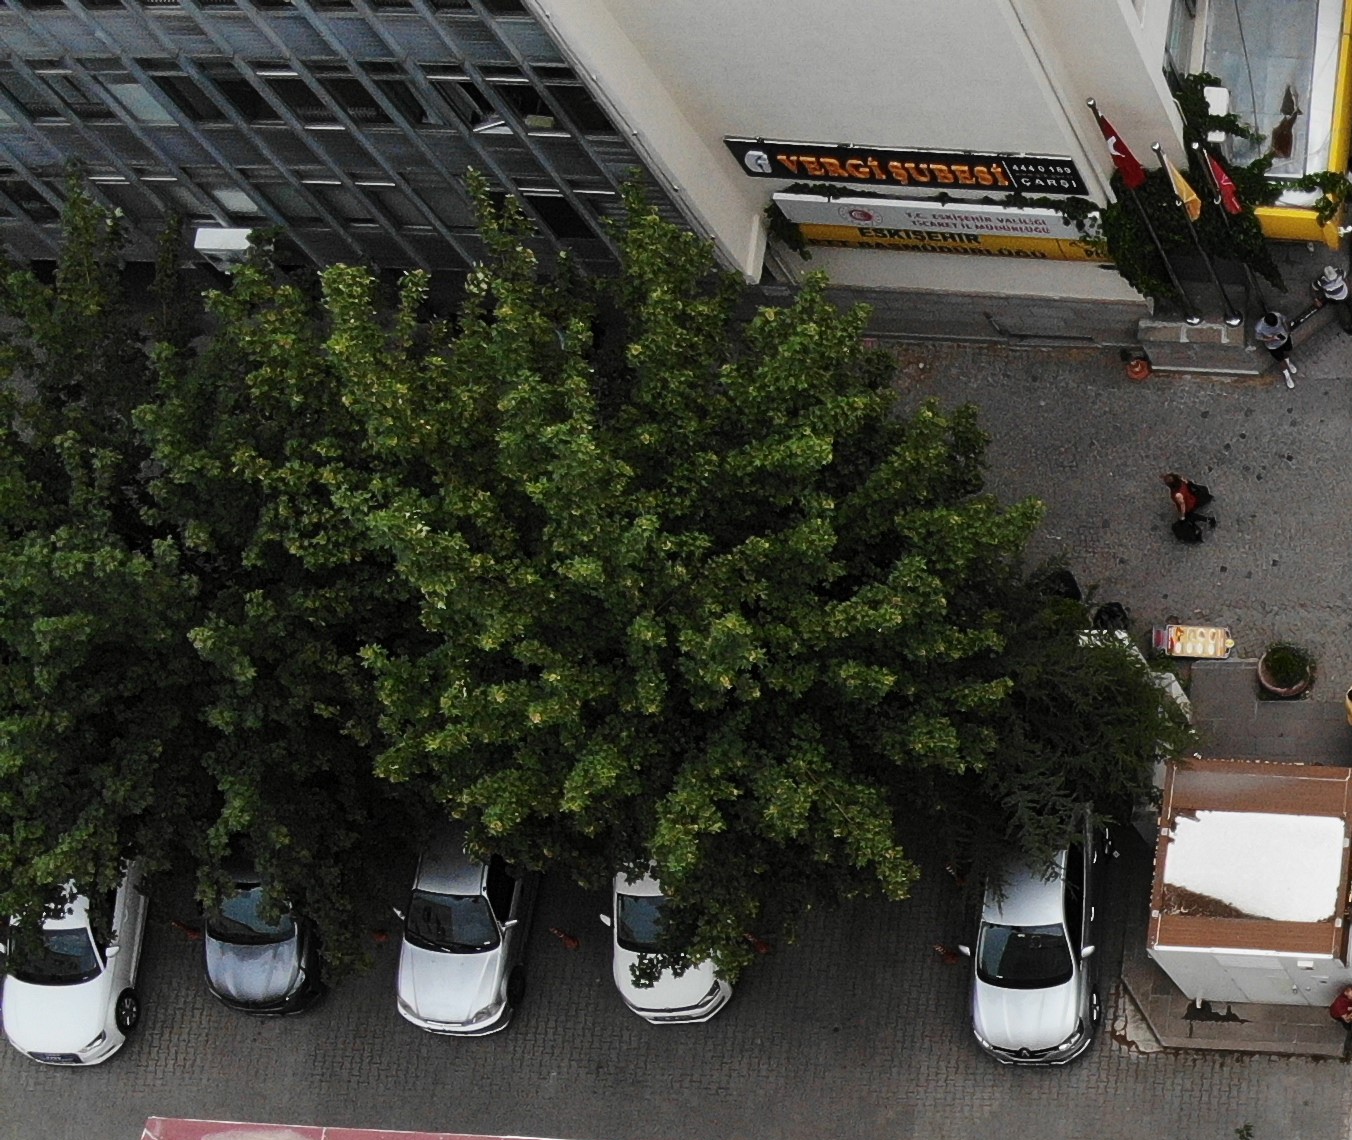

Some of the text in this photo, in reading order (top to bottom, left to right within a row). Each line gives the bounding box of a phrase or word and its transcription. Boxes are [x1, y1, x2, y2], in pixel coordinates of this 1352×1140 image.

[776, 155, 1008, 186] VERGİ ŞUBESİ
[1012, 164, 1035, 172] 444
[1037, 165, 1045, 173] 0
[1021, 177, 1077, 189] ÇARŞI
[931, 213, 992, 224] ESKİŞEHİR
